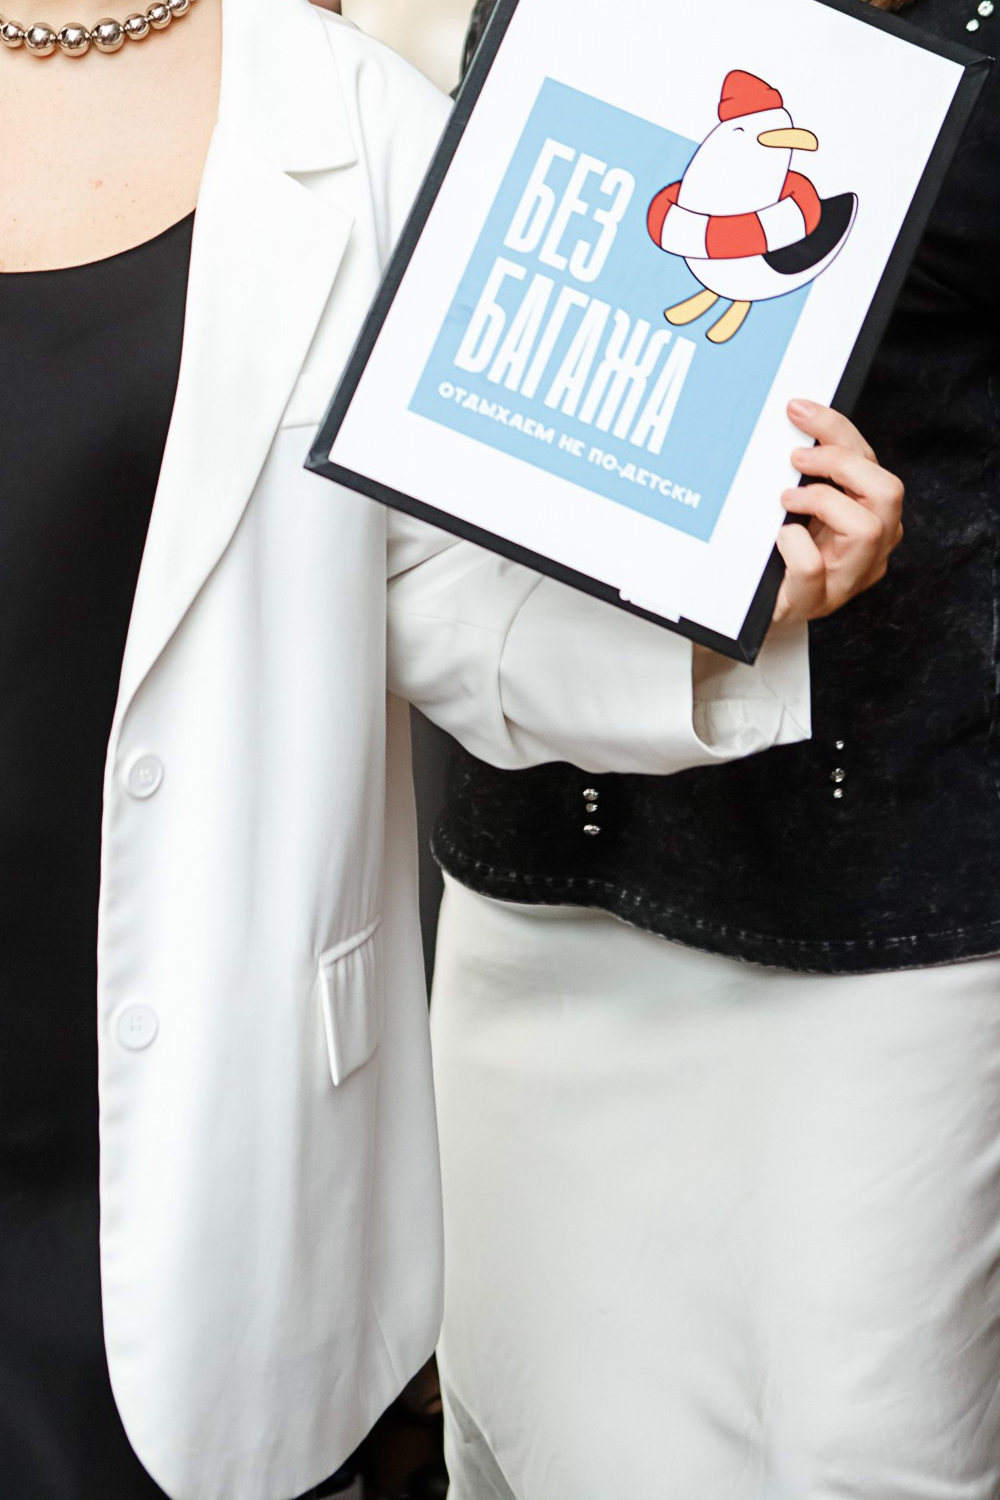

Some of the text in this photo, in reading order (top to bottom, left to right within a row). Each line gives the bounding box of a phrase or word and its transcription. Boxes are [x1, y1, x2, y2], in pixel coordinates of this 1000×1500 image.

[503, 138, 636, 283] БЕЗ
[453, 256, 697, 455] БАГАЖА
[437, 381, 702, 509] ОТДЫХАЕМ НЕ ПО-ДЕТСКИ
